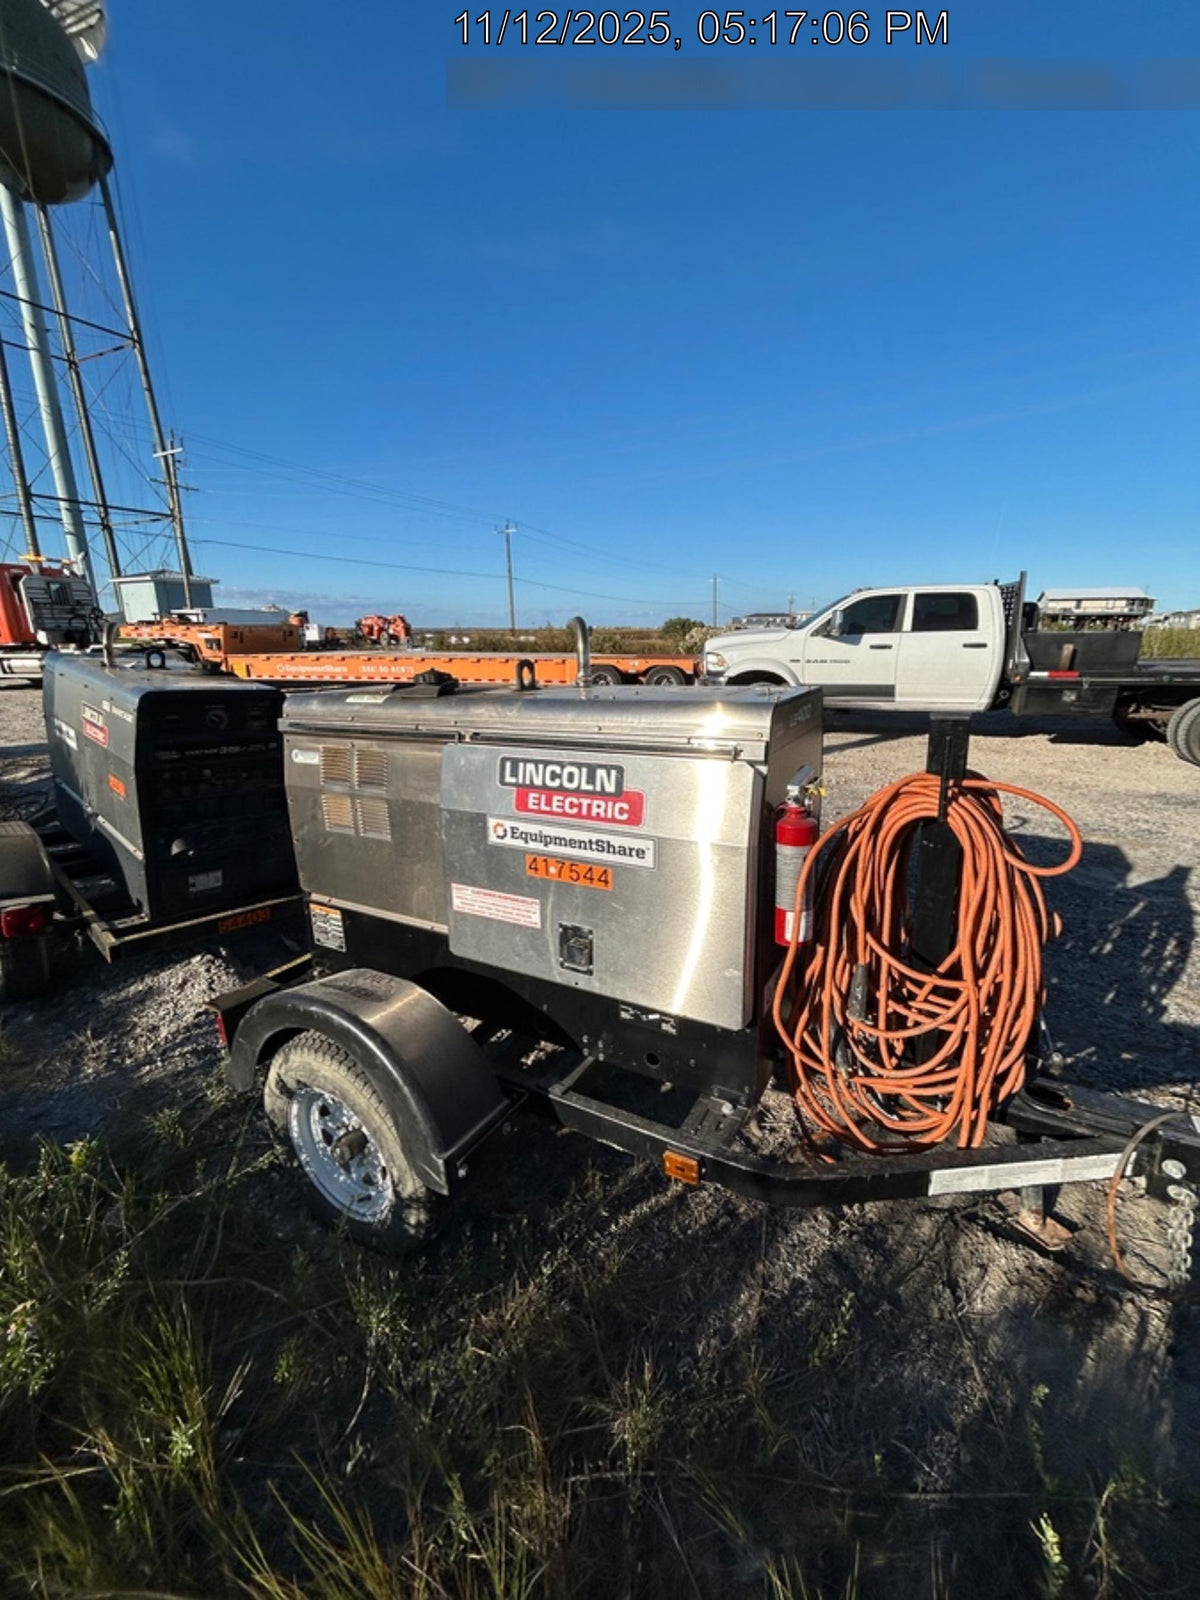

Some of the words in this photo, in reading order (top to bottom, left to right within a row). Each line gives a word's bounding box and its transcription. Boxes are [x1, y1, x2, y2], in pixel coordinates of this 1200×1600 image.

[504, 761, 617, 793] LINCOLN
[527, 793, 630, 820] ELECTRIC
[509, 826, 647, 860] EquipmentShare
[528, 856, 611, 888] 417544
